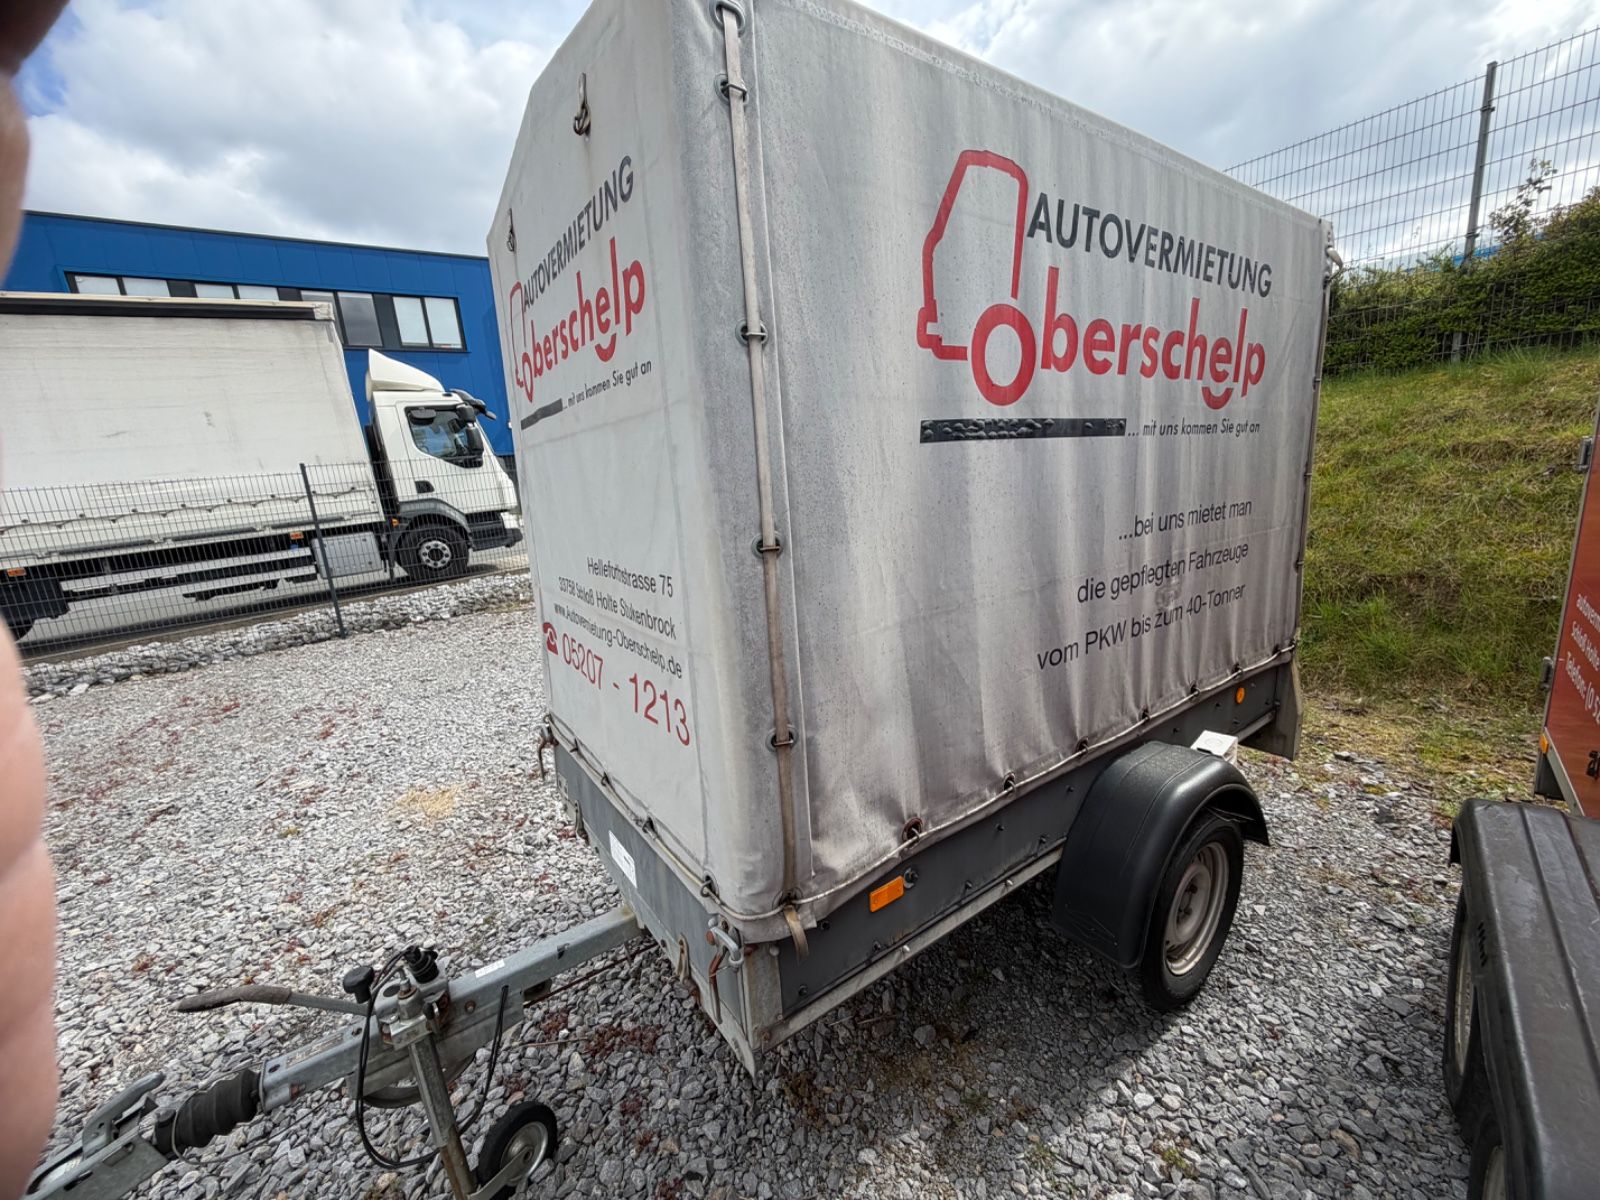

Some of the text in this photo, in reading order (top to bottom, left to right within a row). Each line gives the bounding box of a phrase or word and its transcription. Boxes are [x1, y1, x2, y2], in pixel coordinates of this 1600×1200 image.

[523, 155, 634, 312] AUTOVERMIETUNG
[1027, 192, 1273, 297] AUTOVERMIETUNG
[521, 236, 645, 403] Oberschelp
[971, 265, 1266, 409] Oberschelp
[585, 383, 611, 399] kommen
[612, 369, 624, 387] Sie
[625, 361, 638, 386] gut
[640, 360, 652, 375] an
[1142, 419, 1157, 437] mit
[1160, 423, 1178, 436] uns
[1181, 417, 1218, 436] kommen
[1220, 418, 1234, 434] Sie
[1235, 420, 1248, 438] gut
[1249, 422, 1260, 433] an
[1158, 511, 1185, 532] uns
[1187, 501, 1226, 527] mietet
[1228, 501, 1252, 519] man
[659, 574, 674, 598] 75
[1077, 543, 1249, 603] die gepflegten Fahrzeuge
[595, 591, 618, 614] Holte
[619, 597, 677, 640] Stukenbrock
[1036, 583, 1246, 670] vom PKW bis zum 40-Tonner
[562, 633, 604, 690] 05207
[629, 673, 691, 746] 1213
